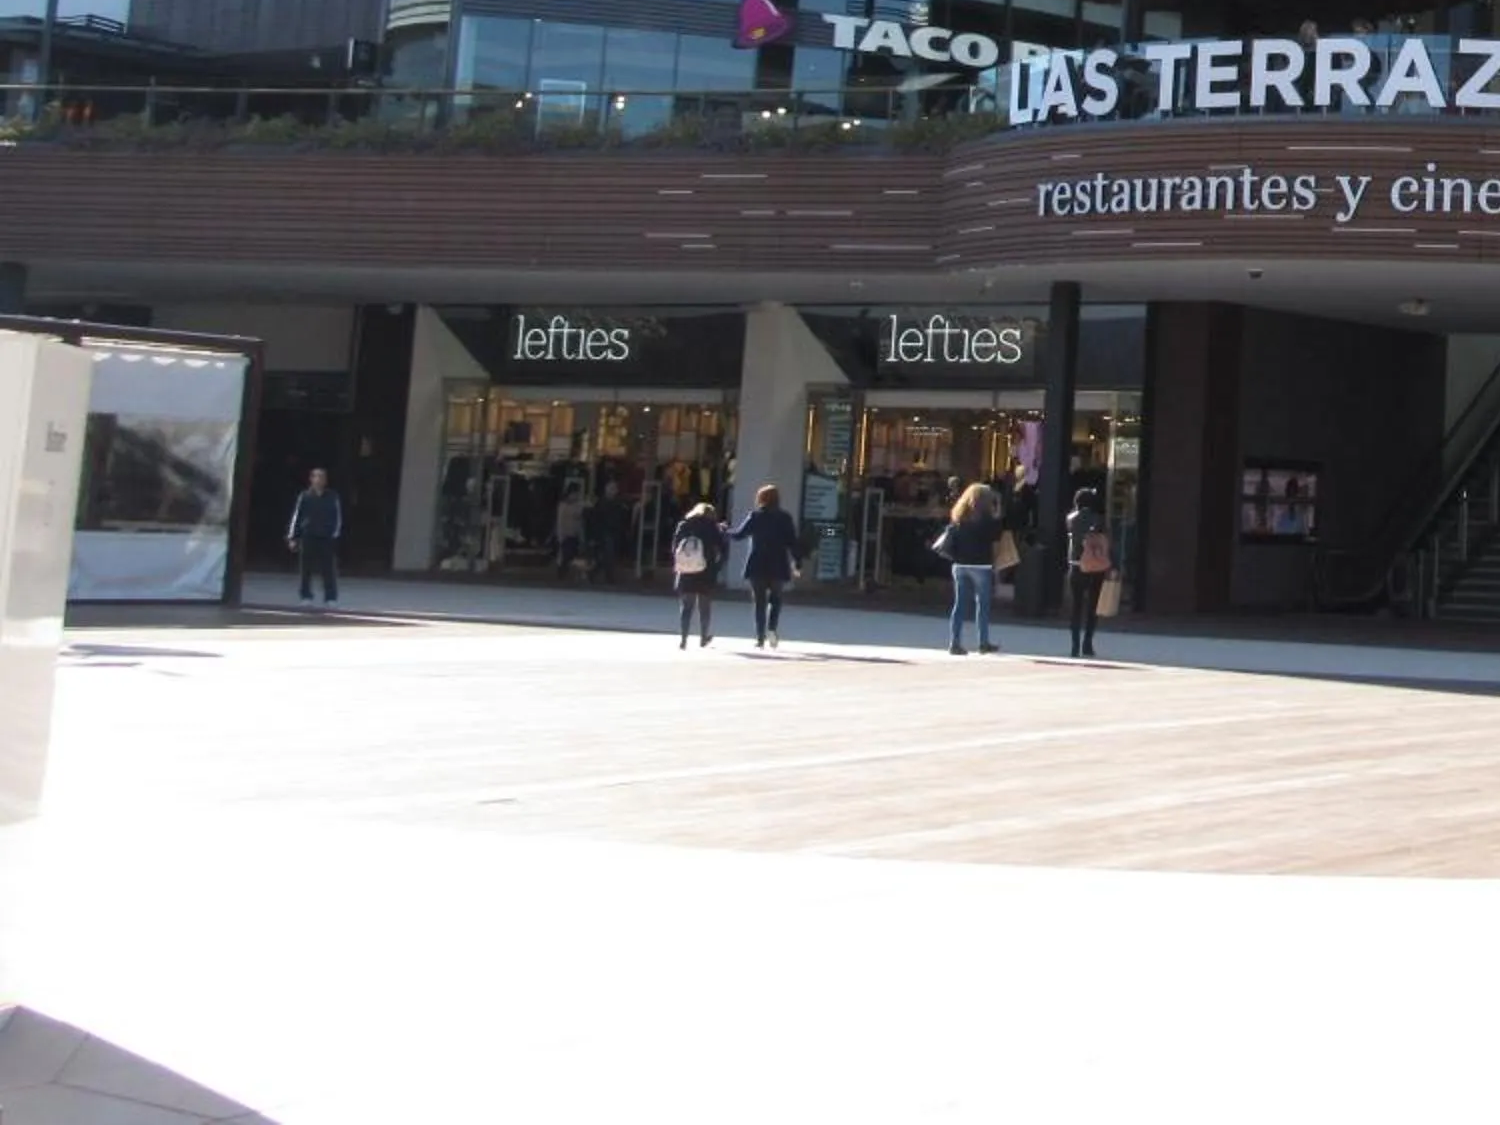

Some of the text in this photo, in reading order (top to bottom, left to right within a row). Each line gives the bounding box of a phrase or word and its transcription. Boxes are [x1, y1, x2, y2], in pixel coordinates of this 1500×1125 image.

[821, 13, 999, 68] TACO
[1009, 48, 1119, 125] LAS
[1037, 168, 1317, 217] restaurantes
[1336, 176, 1371, 221] y
[513, 315, 630, 361] lefties
[886, 315, 1022, 363] lefties
